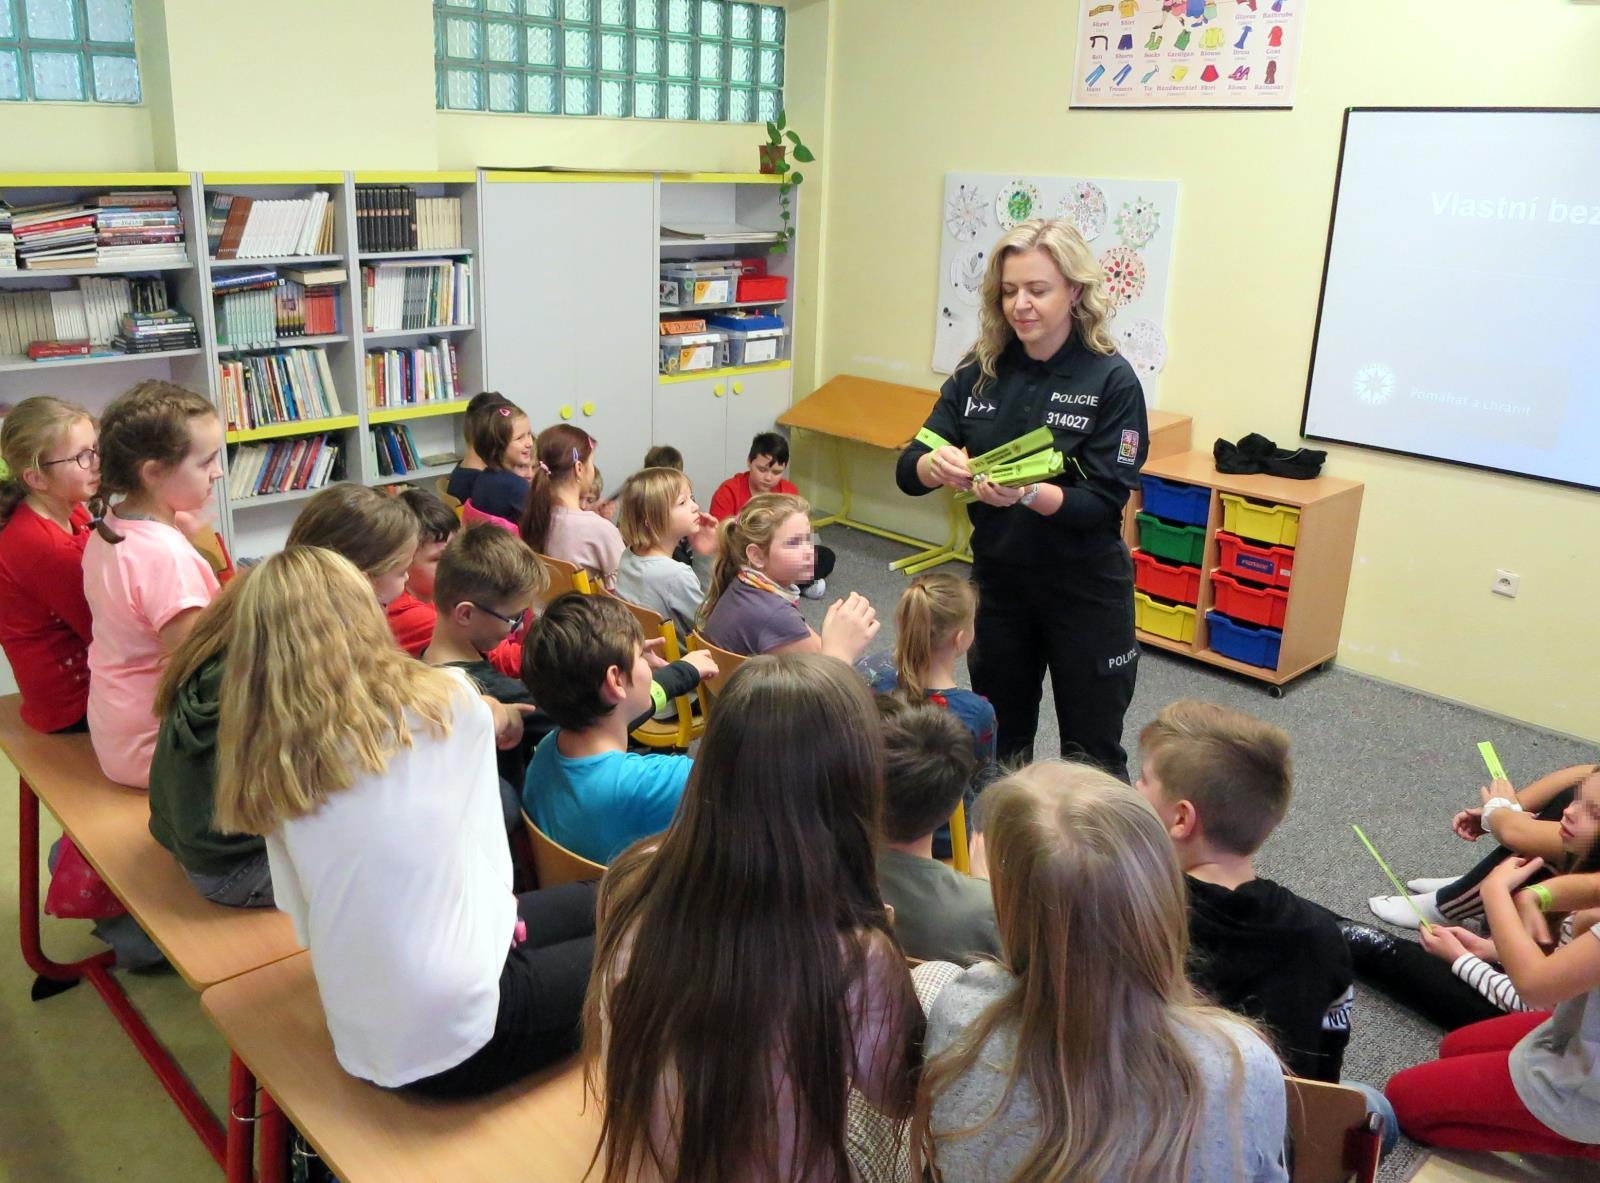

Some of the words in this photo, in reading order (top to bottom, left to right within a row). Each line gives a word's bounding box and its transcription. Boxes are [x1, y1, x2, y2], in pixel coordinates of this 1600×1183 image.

[1431, 191, 1541, 221] Vlastní
[1050, 391, 1099, 407] POLICIE
[1046, 411, 1090, 430] 314027
